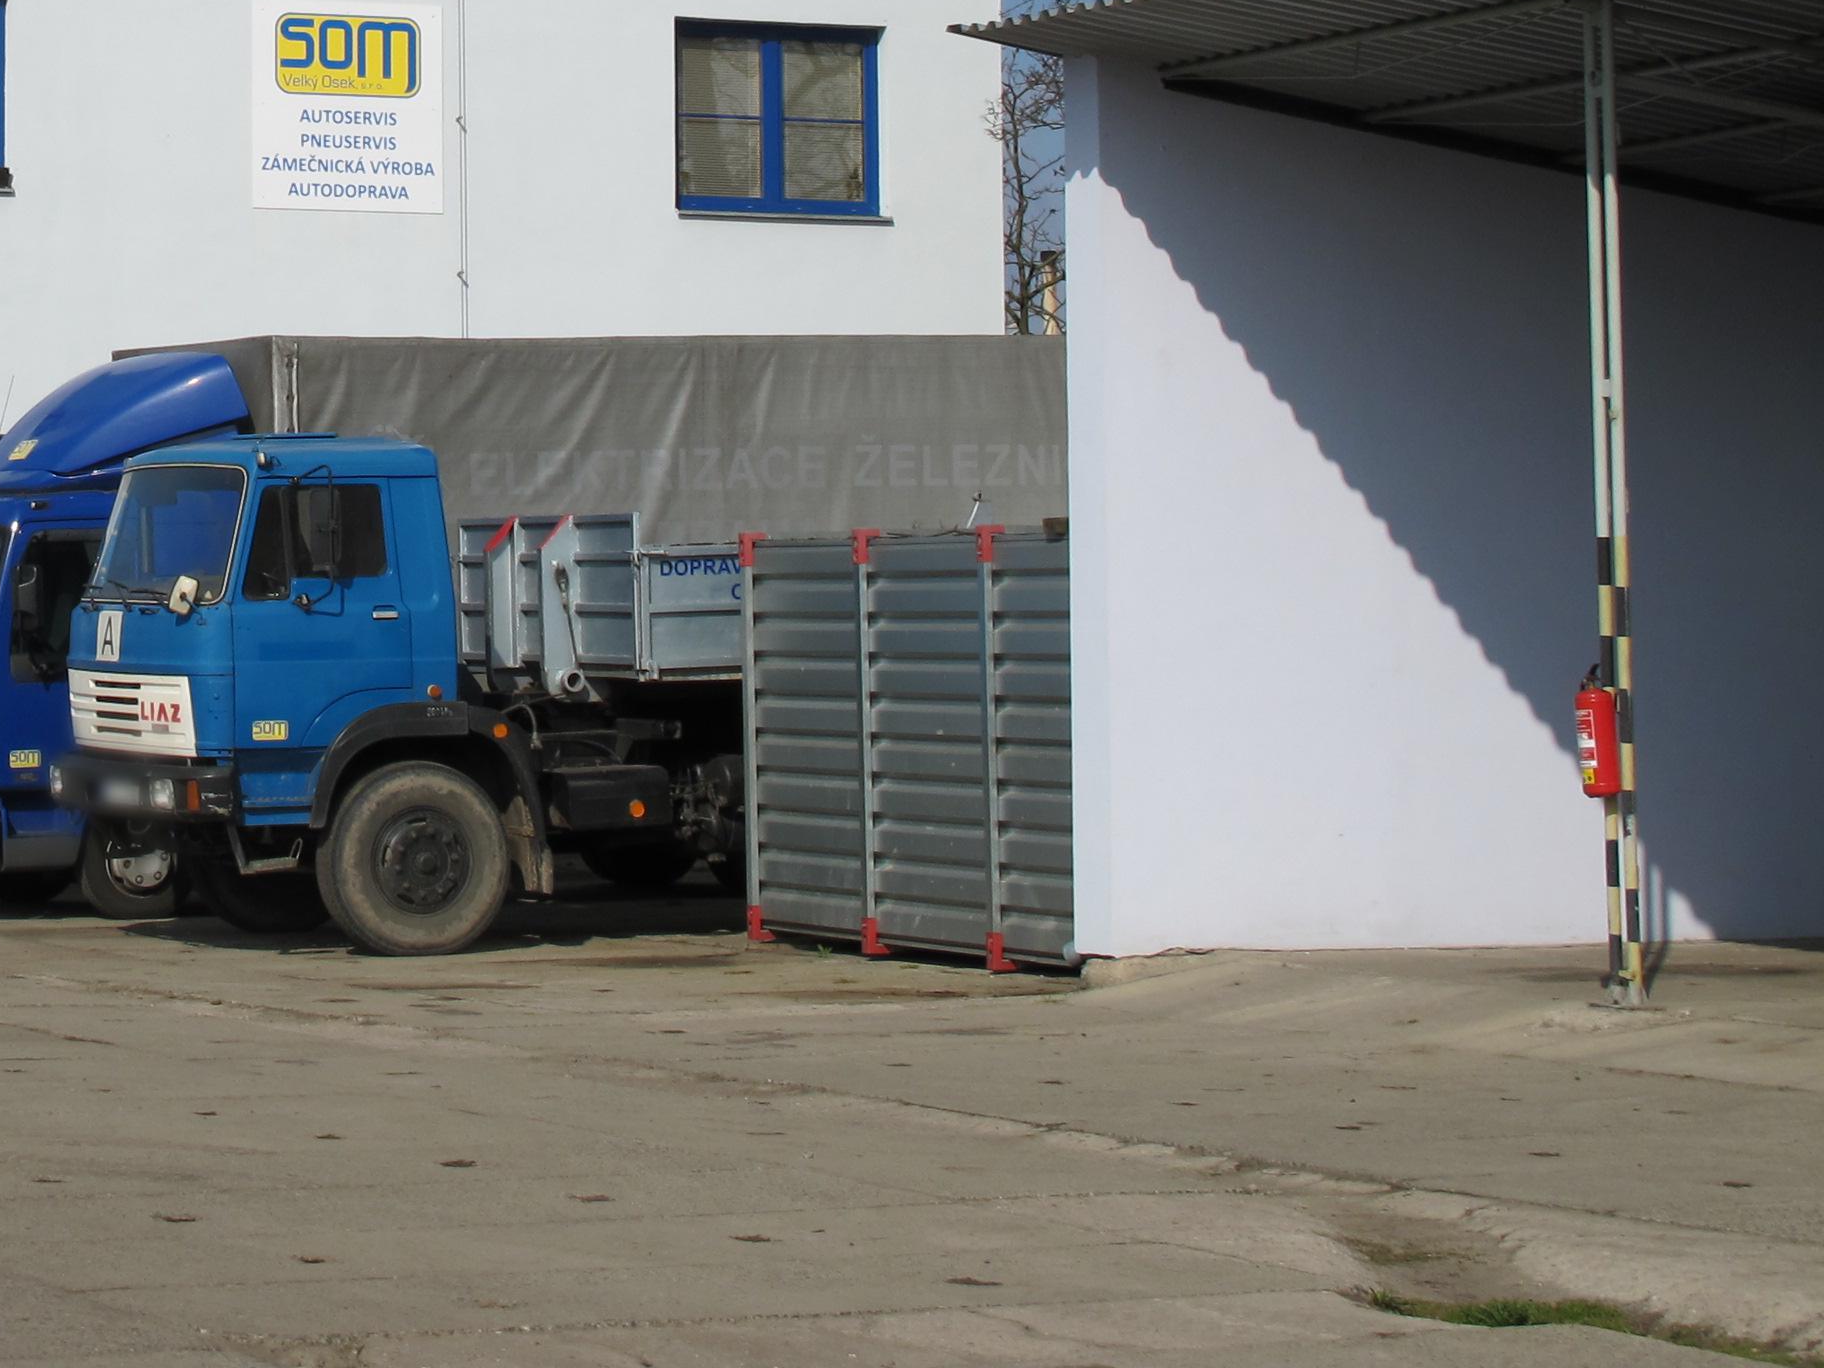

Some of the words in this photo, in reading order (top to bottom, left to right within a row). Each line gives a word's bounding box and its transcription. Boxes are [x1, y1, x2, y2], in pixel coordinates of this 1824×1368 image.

[299, 109, 397, 126] AUTOSERVIS
[300, 133, 397, 150] PNEUSERVIS
[261, 155, 366, 174] ZÁMEČNICKÁ
[370, 158, 435, 176] VÝROBA
[288, 182, 410, 200] AUTODOPRAVA
[101, 615, 115, 656] A
[140, 700, 182, 723] LIAZ
